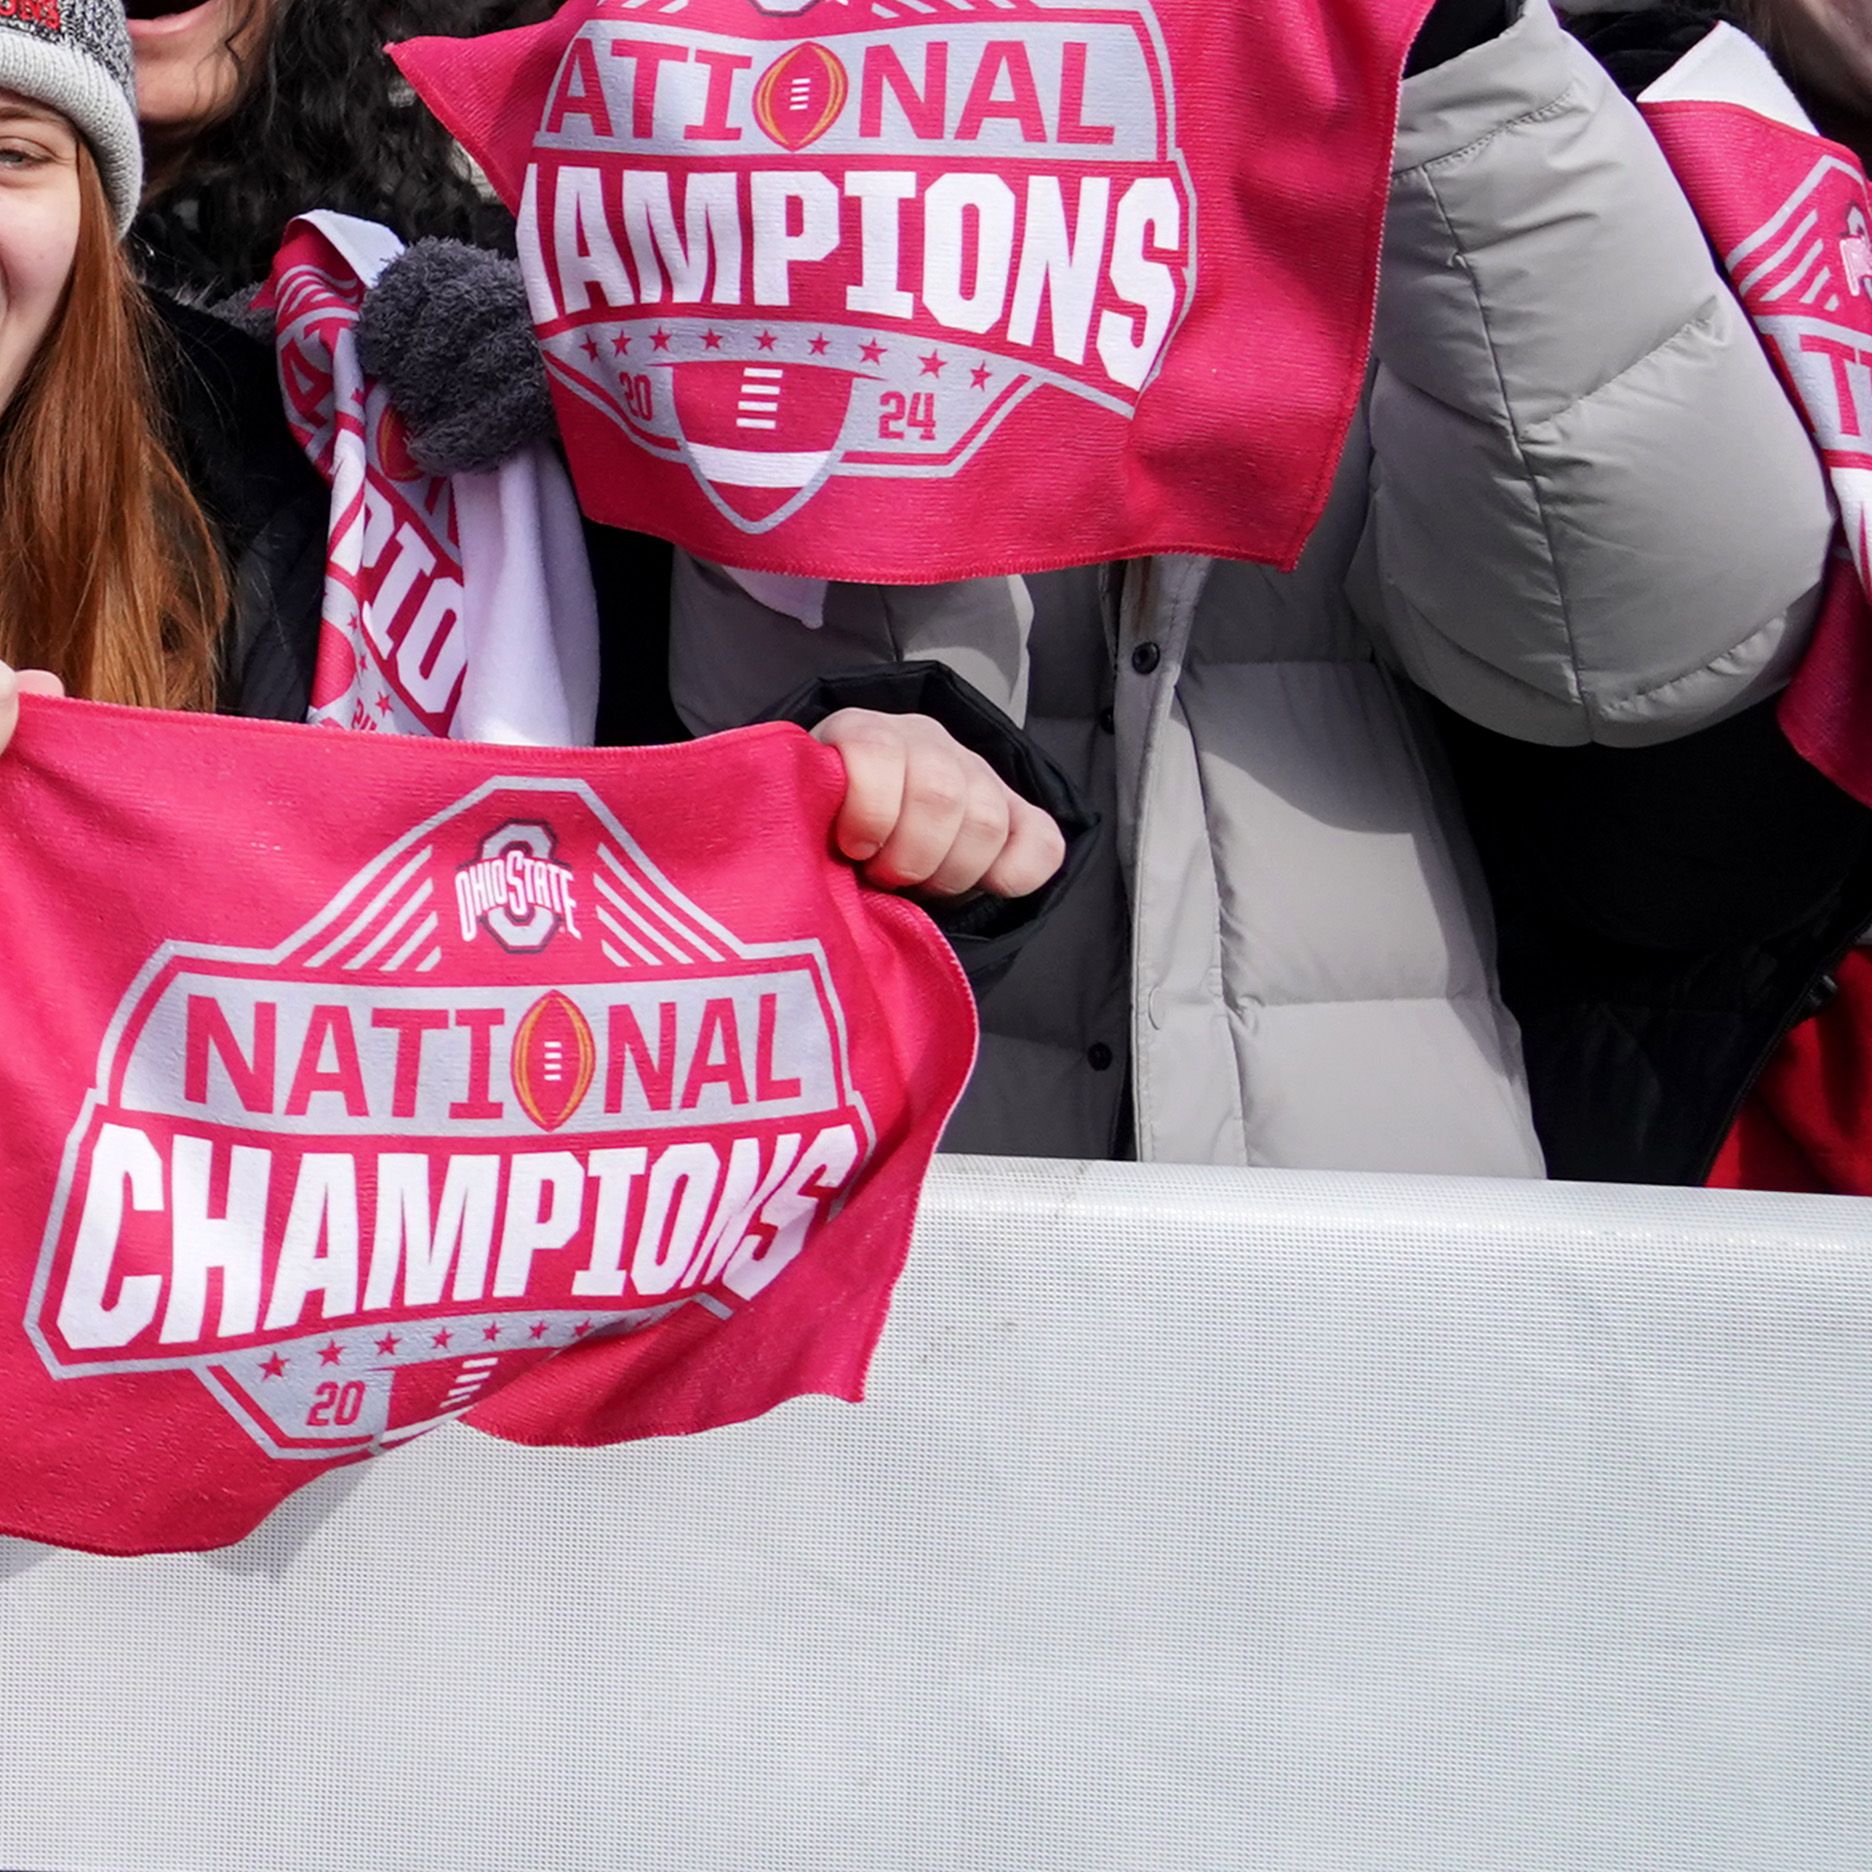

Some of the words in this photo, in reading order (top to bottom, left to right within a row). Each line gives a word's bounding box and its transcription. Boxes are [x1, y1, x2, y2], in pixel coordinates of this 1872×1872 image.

[547, 40, 1115, 152] ATIONAL
[518, 165, 1186, 390] AMPIONS
[879, 389, 936, 440] 24
[455, 859, 507, 942] OHIO
[505, 850, 583, 940] STATE
[57, 1122, 858, 1350] CHAMPIONS
[305, 1380, 367, 1428] 20
